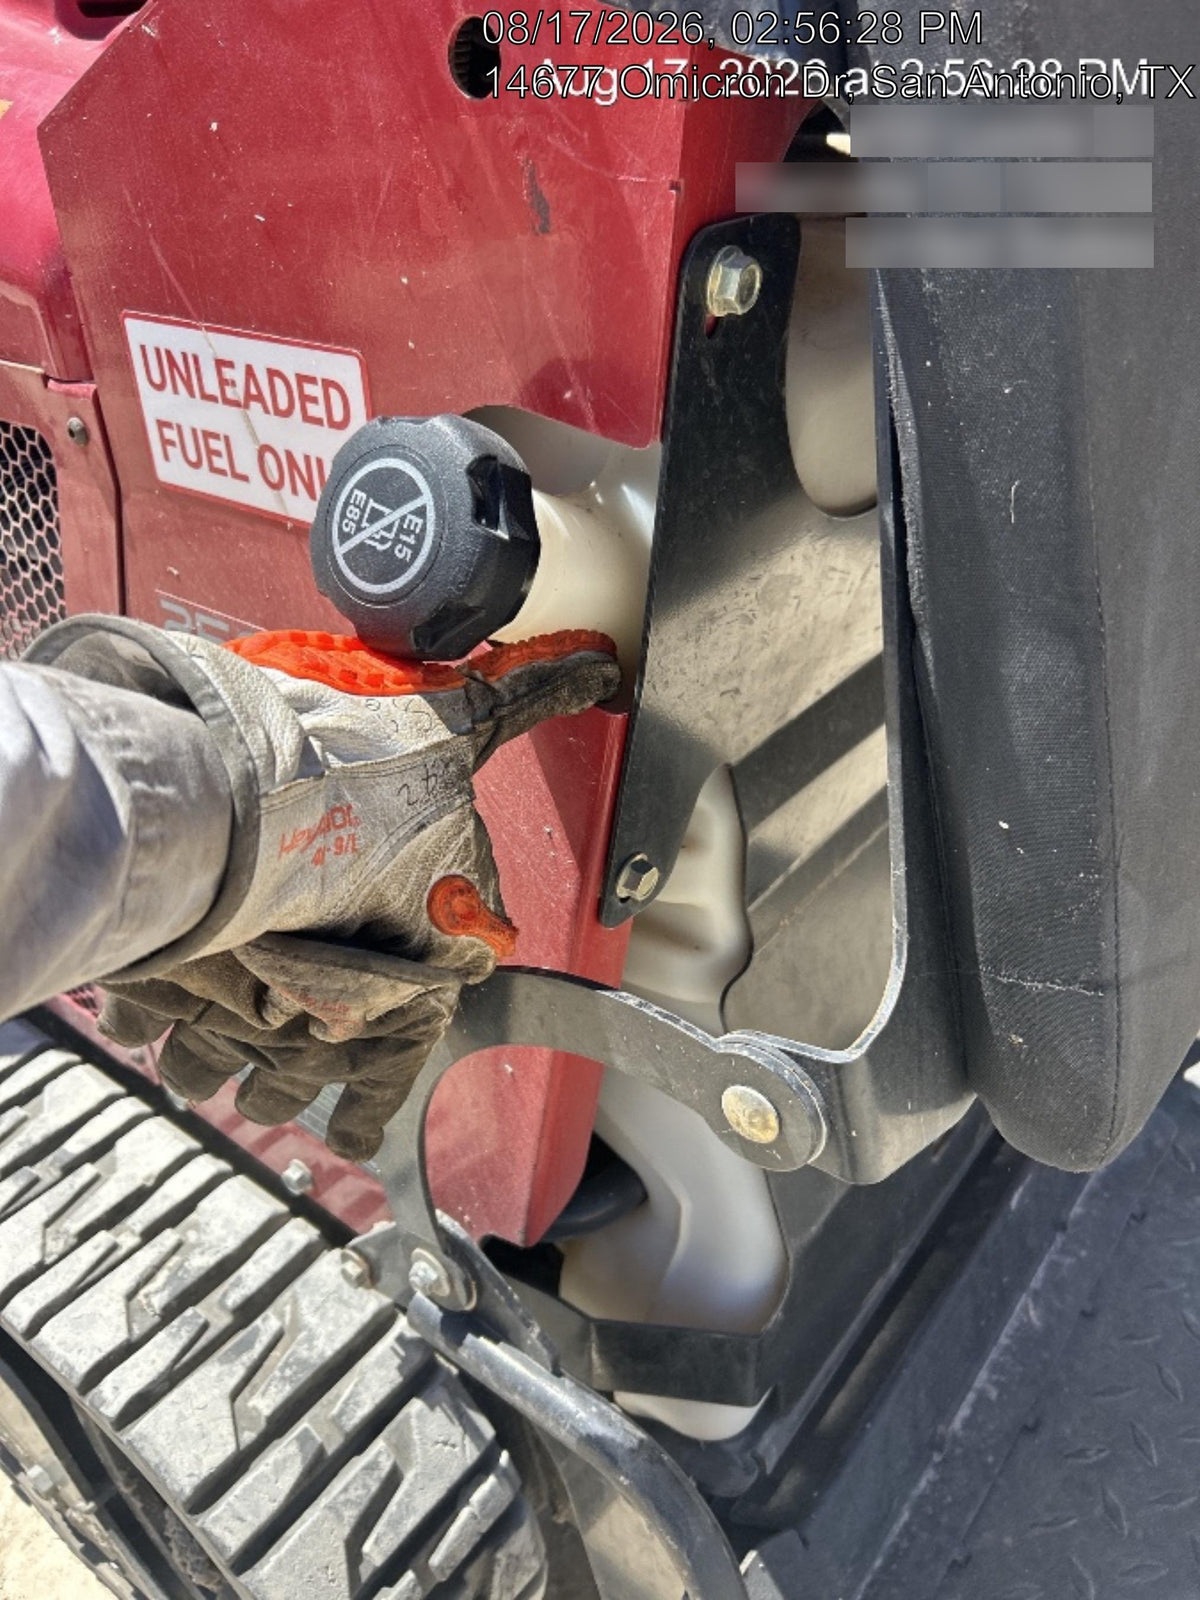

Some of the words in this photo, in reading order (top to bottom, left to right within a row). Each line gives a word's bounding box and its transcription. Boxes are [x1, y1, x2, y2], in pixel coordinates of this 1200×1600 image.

[139, 344, 351, 431] UNLEADED
[155, 418, 250, 483] FUEL
[257, 443, 328, 502] ONL
[342, 488, 366, 535] E85
[394, 514, 424, 562] E15
